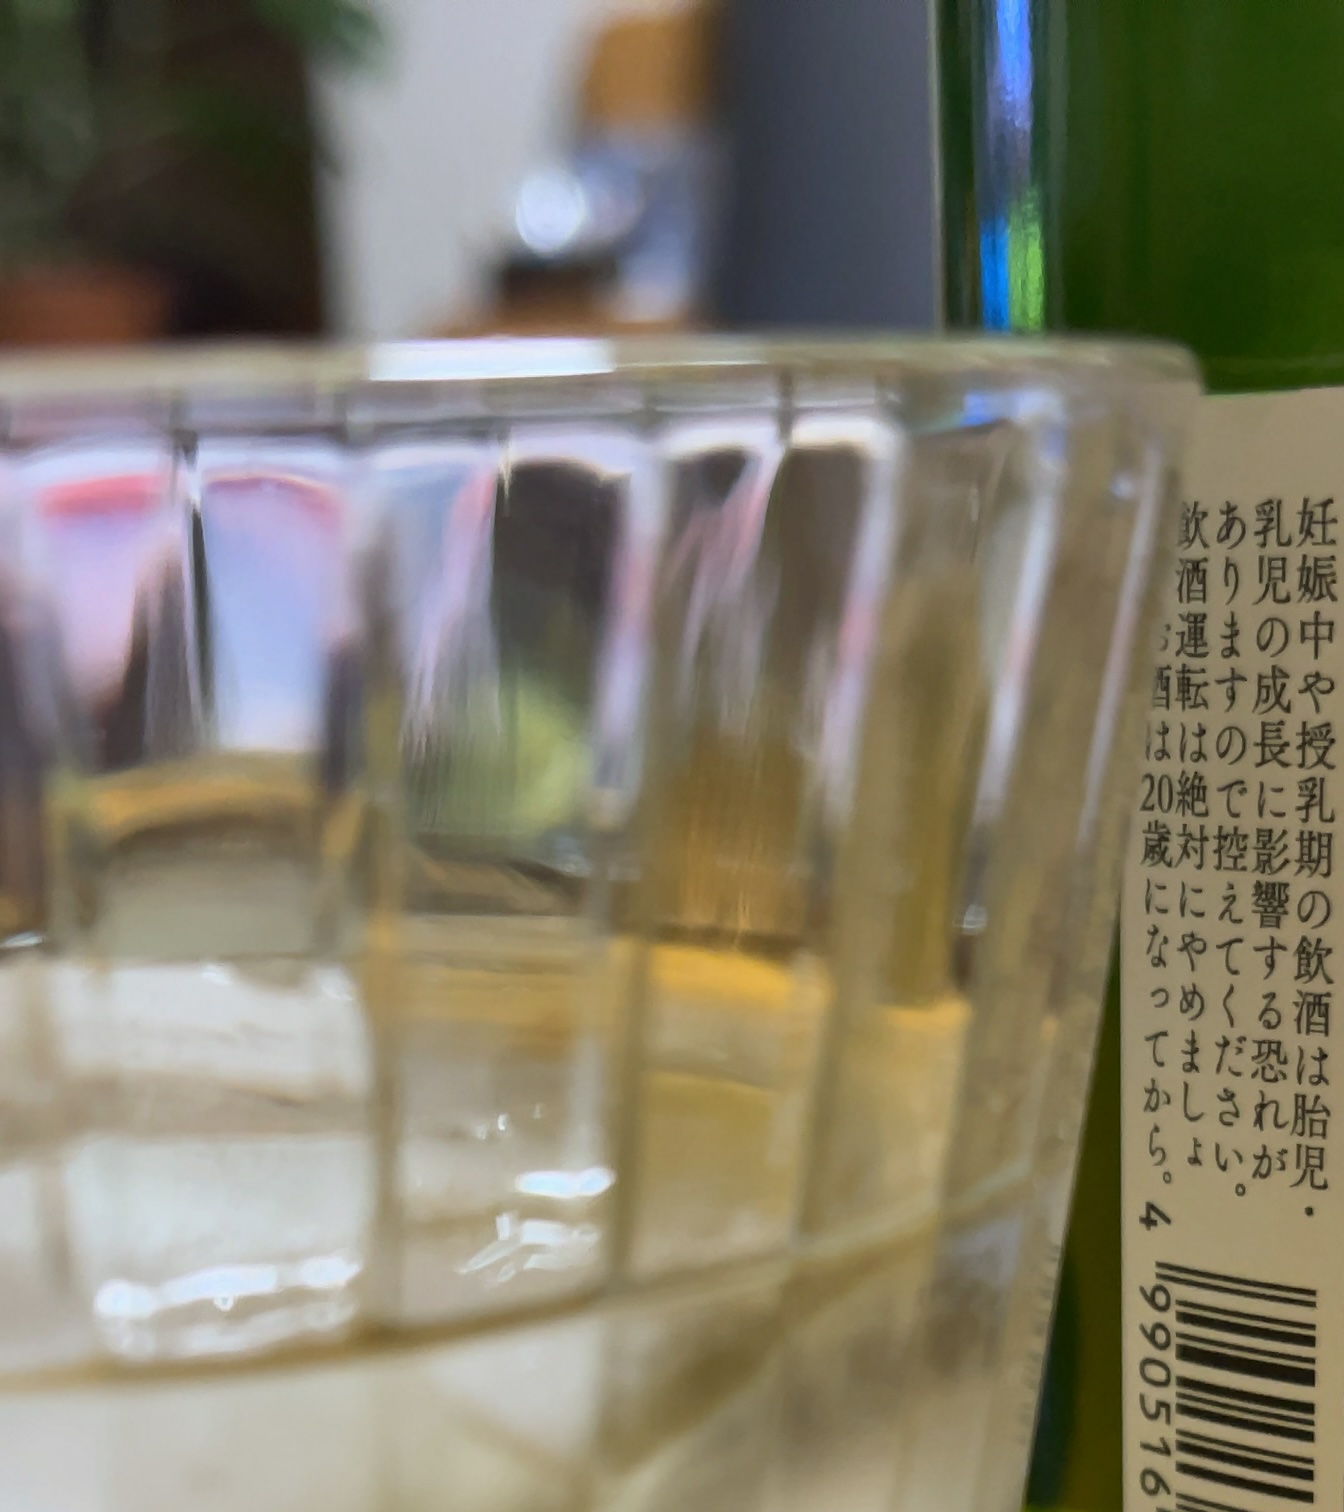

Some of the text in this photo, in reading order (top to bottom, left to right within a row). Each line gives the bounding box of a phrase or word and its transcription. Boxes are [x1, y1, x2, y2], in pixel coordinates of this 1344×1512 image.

[1212, 500, 1248, 1197] ありますので控えてください。
[1251, 498, 1292, 1181] 乳児の成長に影響する恐れが
[1139, 1202, 1172, 1230] 4
[1140, 1284, 1171, 1496] 990516
